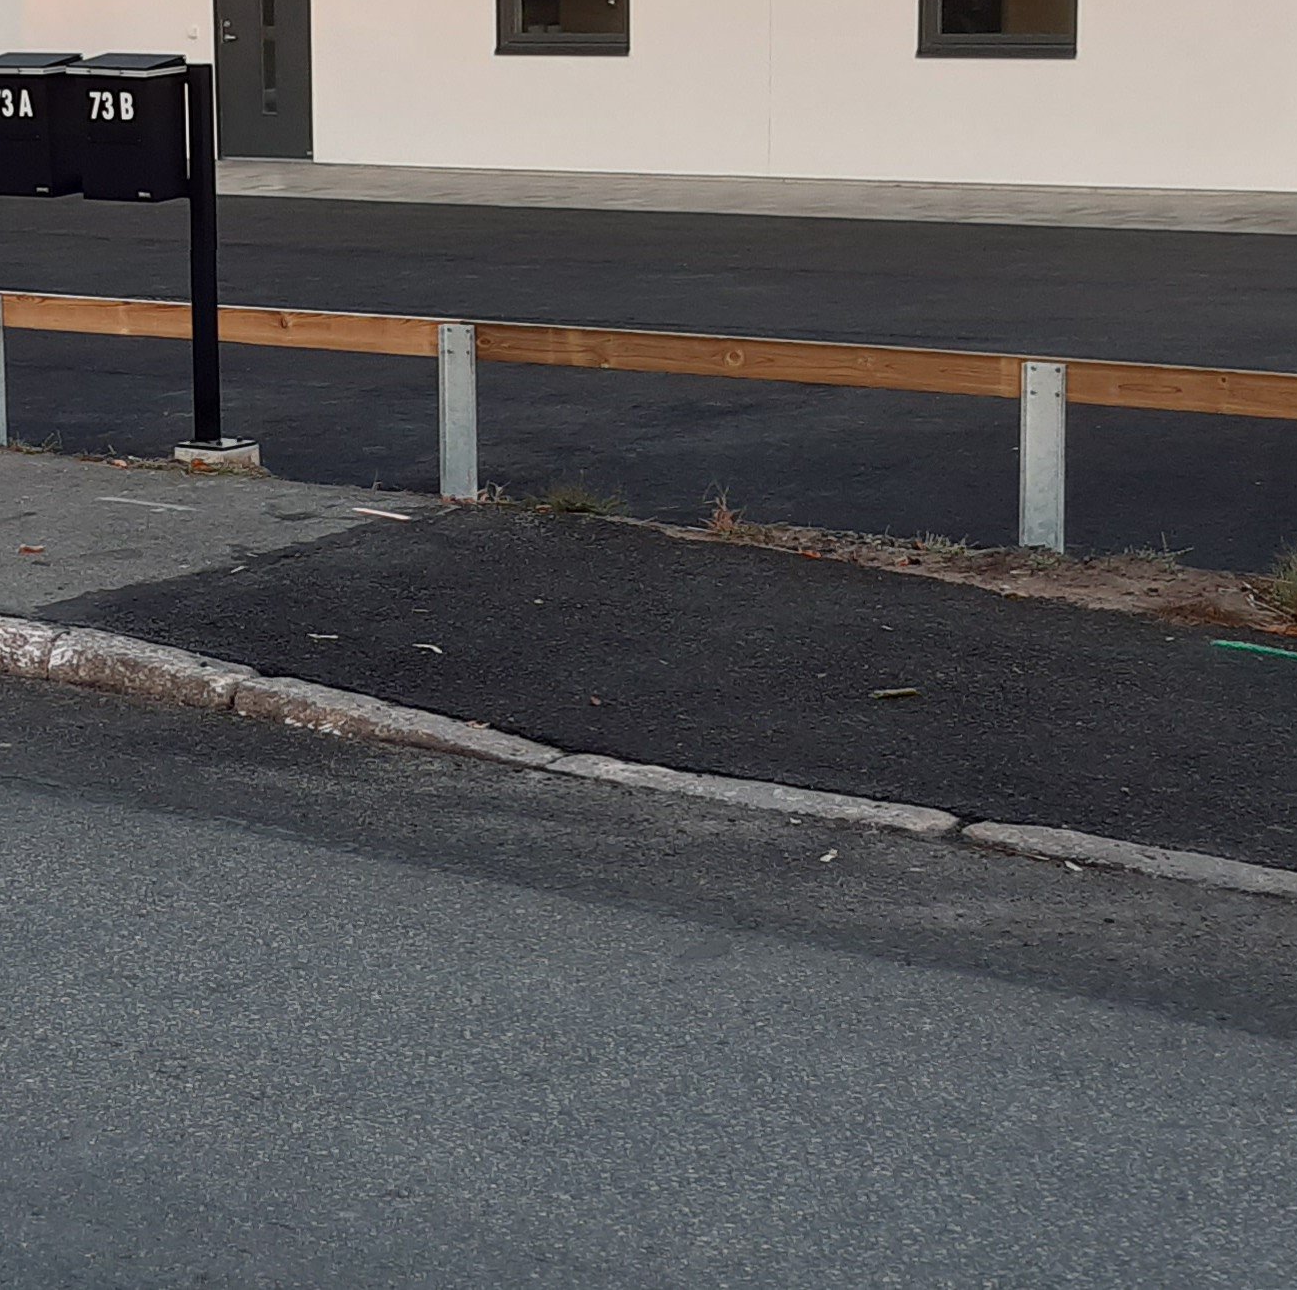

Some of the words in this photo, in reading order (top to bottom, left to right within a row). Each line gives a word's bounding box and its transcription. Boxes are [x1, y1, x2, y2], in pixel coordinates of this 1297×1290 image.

[19, 89, 33, 117] A
[89, 91, 115, 120] 73
[120, 92, 134, 120] B
